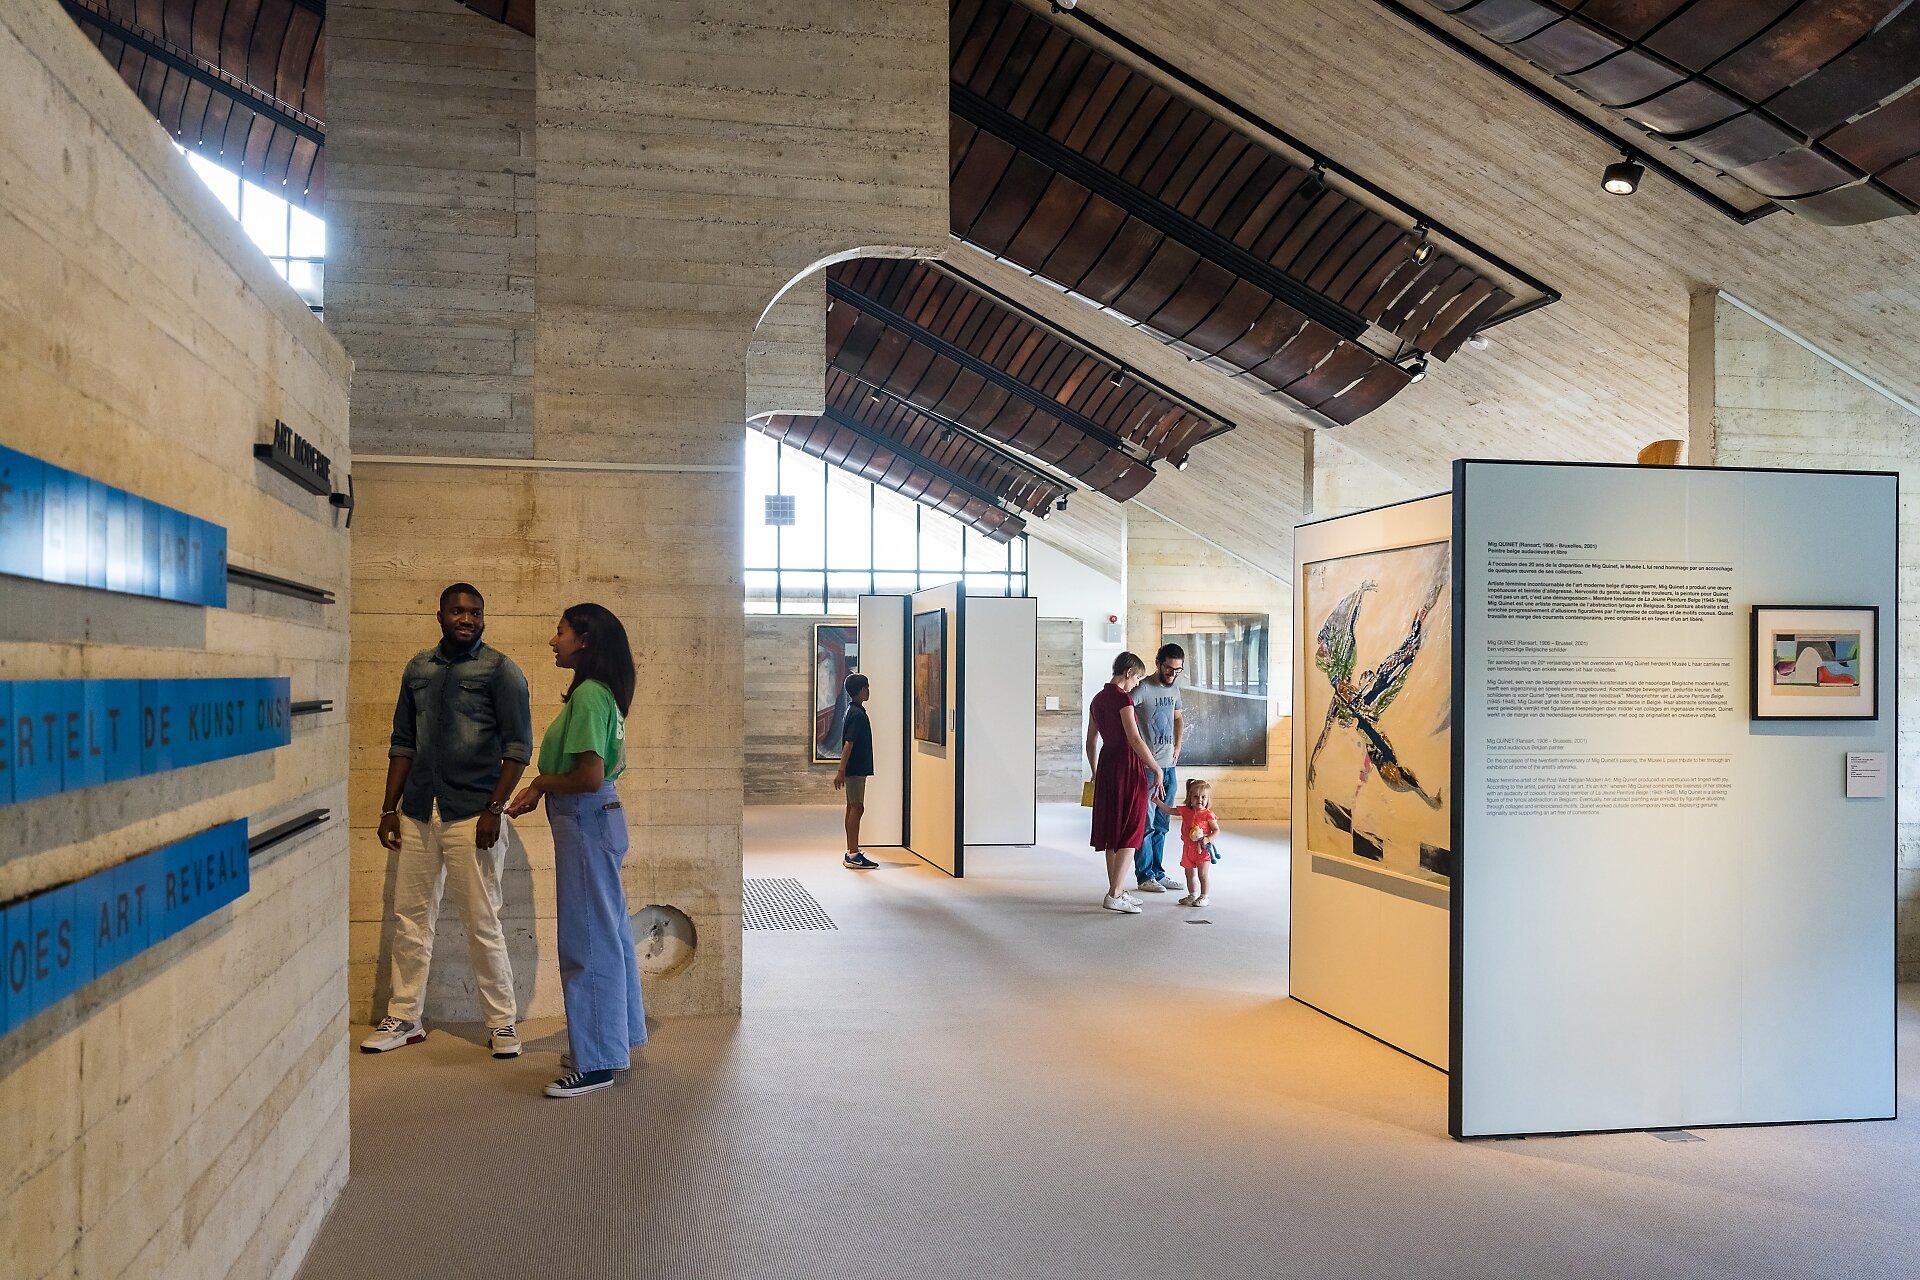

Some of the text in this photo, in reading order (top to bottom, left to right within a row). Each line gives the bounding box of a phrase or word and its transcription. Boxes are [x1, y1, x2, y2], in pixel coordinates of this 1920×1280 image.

[143, 704, 171, 748] DE
[188, 699, 245, 741] KUNST
[9, 919, 71, 993] OES
[99, 884, 147, 947] ART
